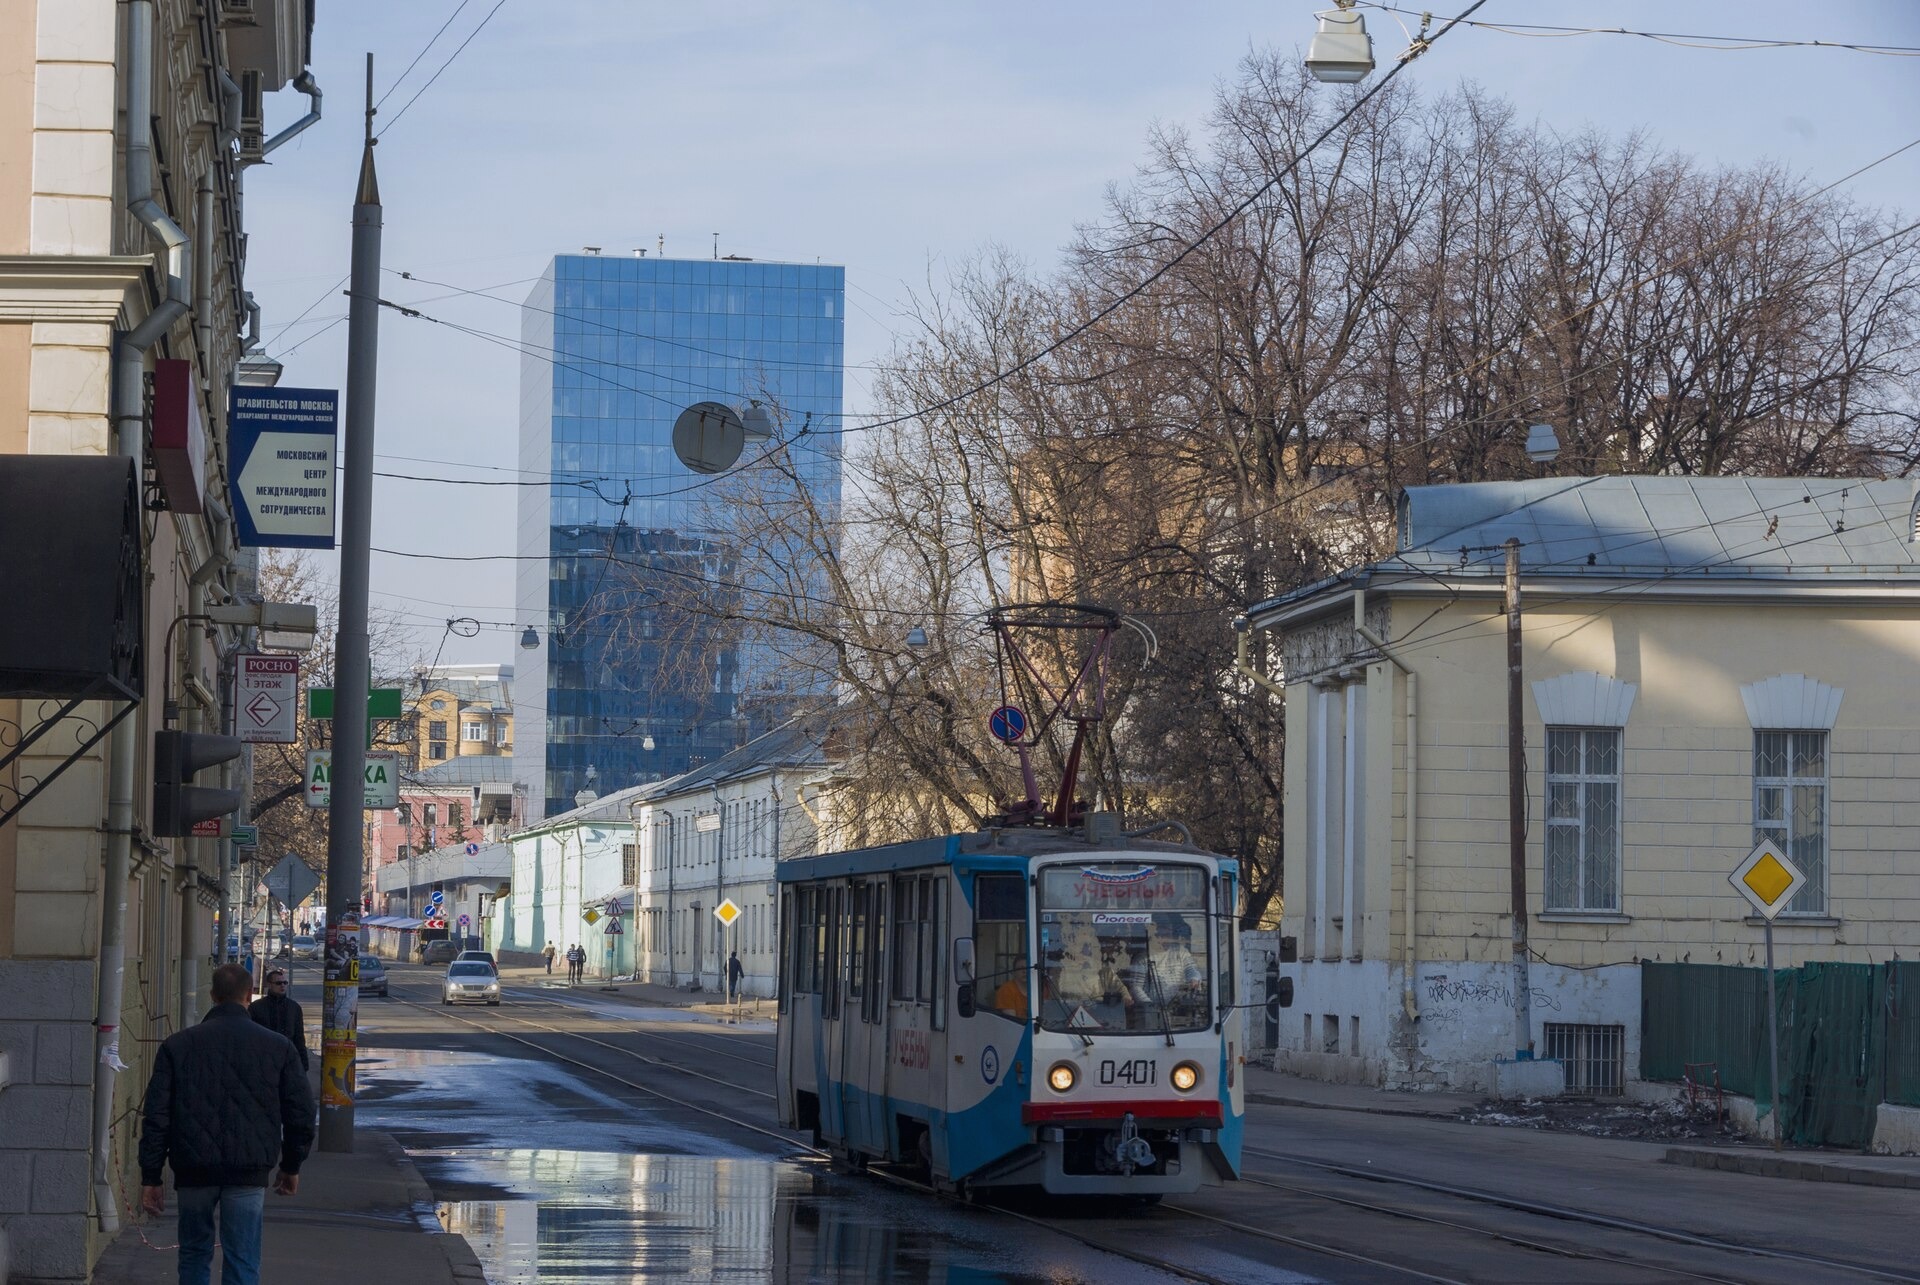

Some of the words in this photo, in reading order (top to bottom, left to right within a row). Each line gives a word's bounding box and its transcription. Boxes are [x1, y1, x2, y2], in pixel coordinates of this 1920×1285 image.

[237, 398, 298, 410] ПРАВИТЕЛЬСТВО
[300, 400, 334, 412] МОСКВЫ
[271, 414, 314, 422] МЕЖДУНАРОДНЫХ
[277, 450, 328, 460] МОСКОВСКИЙ
[304, 469, 326, 480] ЦЕНТР
[256, 486, 326, 498] МЕЖДУНАРОДНОГО
[260, 504, 326, 516] СОТРУДНИЧЕСТВА
[249, 660, 292, 672] РОСНО
[244, 678, 250, 688] 1
[254, 680, 282, 688] этаж
[1074, 882, 1174, 898] УЧЕБНЫЙ
[1094, 914, 1150, 922] Pioneer
[1100, 1060, 1156, 1084] 0401
